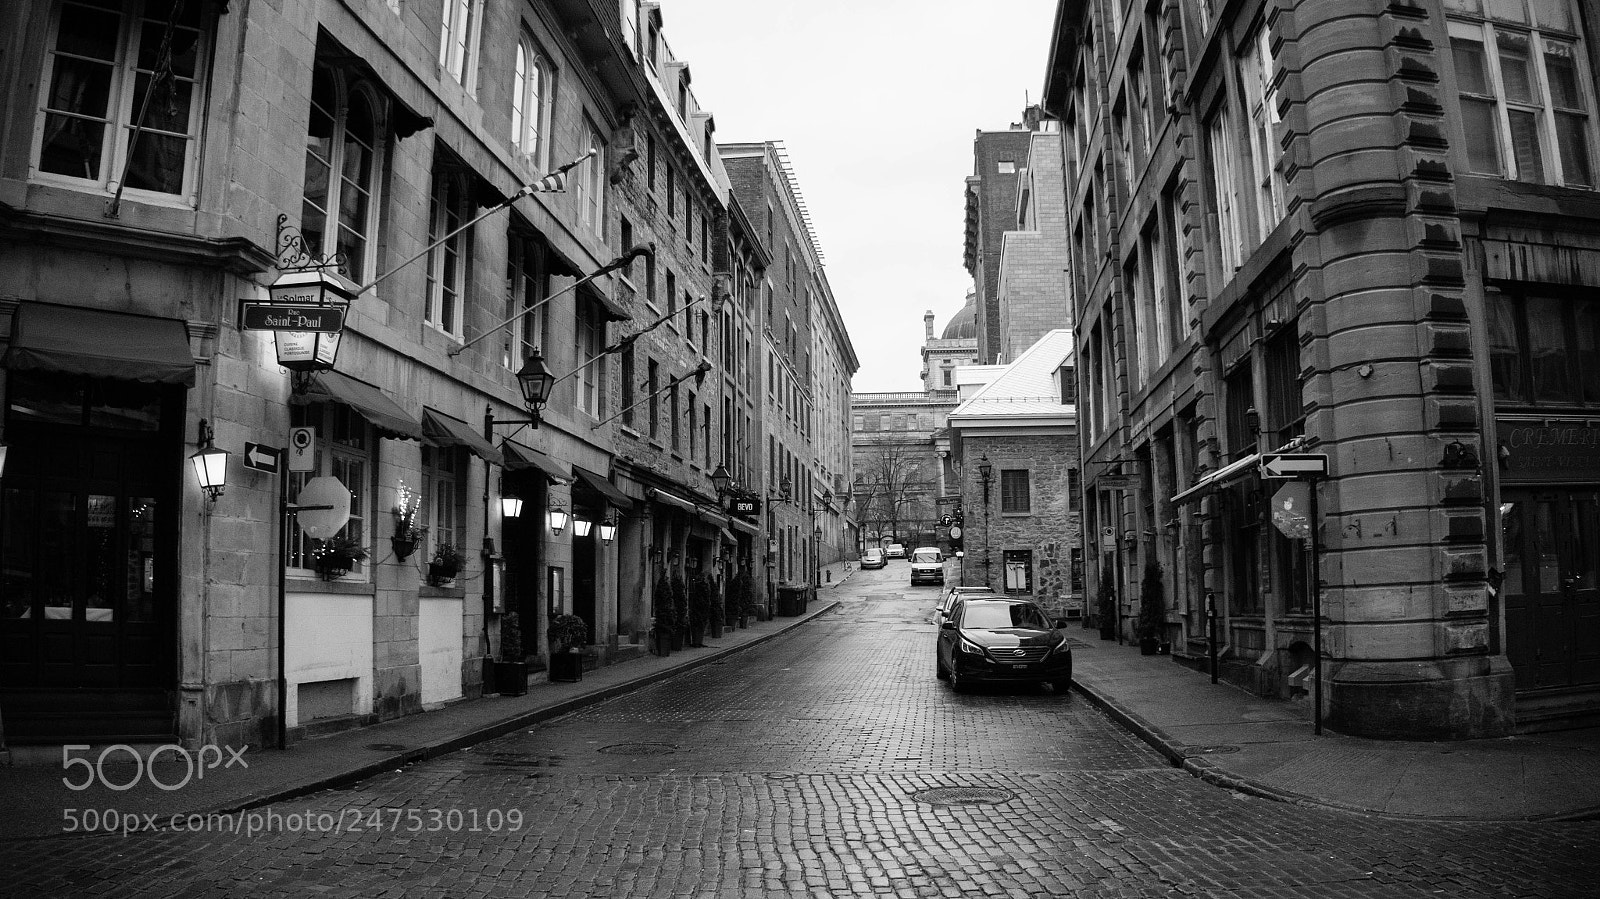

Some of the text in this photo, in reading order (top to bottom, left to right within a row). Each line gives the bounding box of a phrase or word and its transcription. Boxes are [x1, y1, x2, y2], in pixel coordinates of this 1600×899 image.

[282, 293, 315, 302] Solmar
[264, 314, 322, 328] Saint-Paul
[737, 502, 753, 511] BEVO
